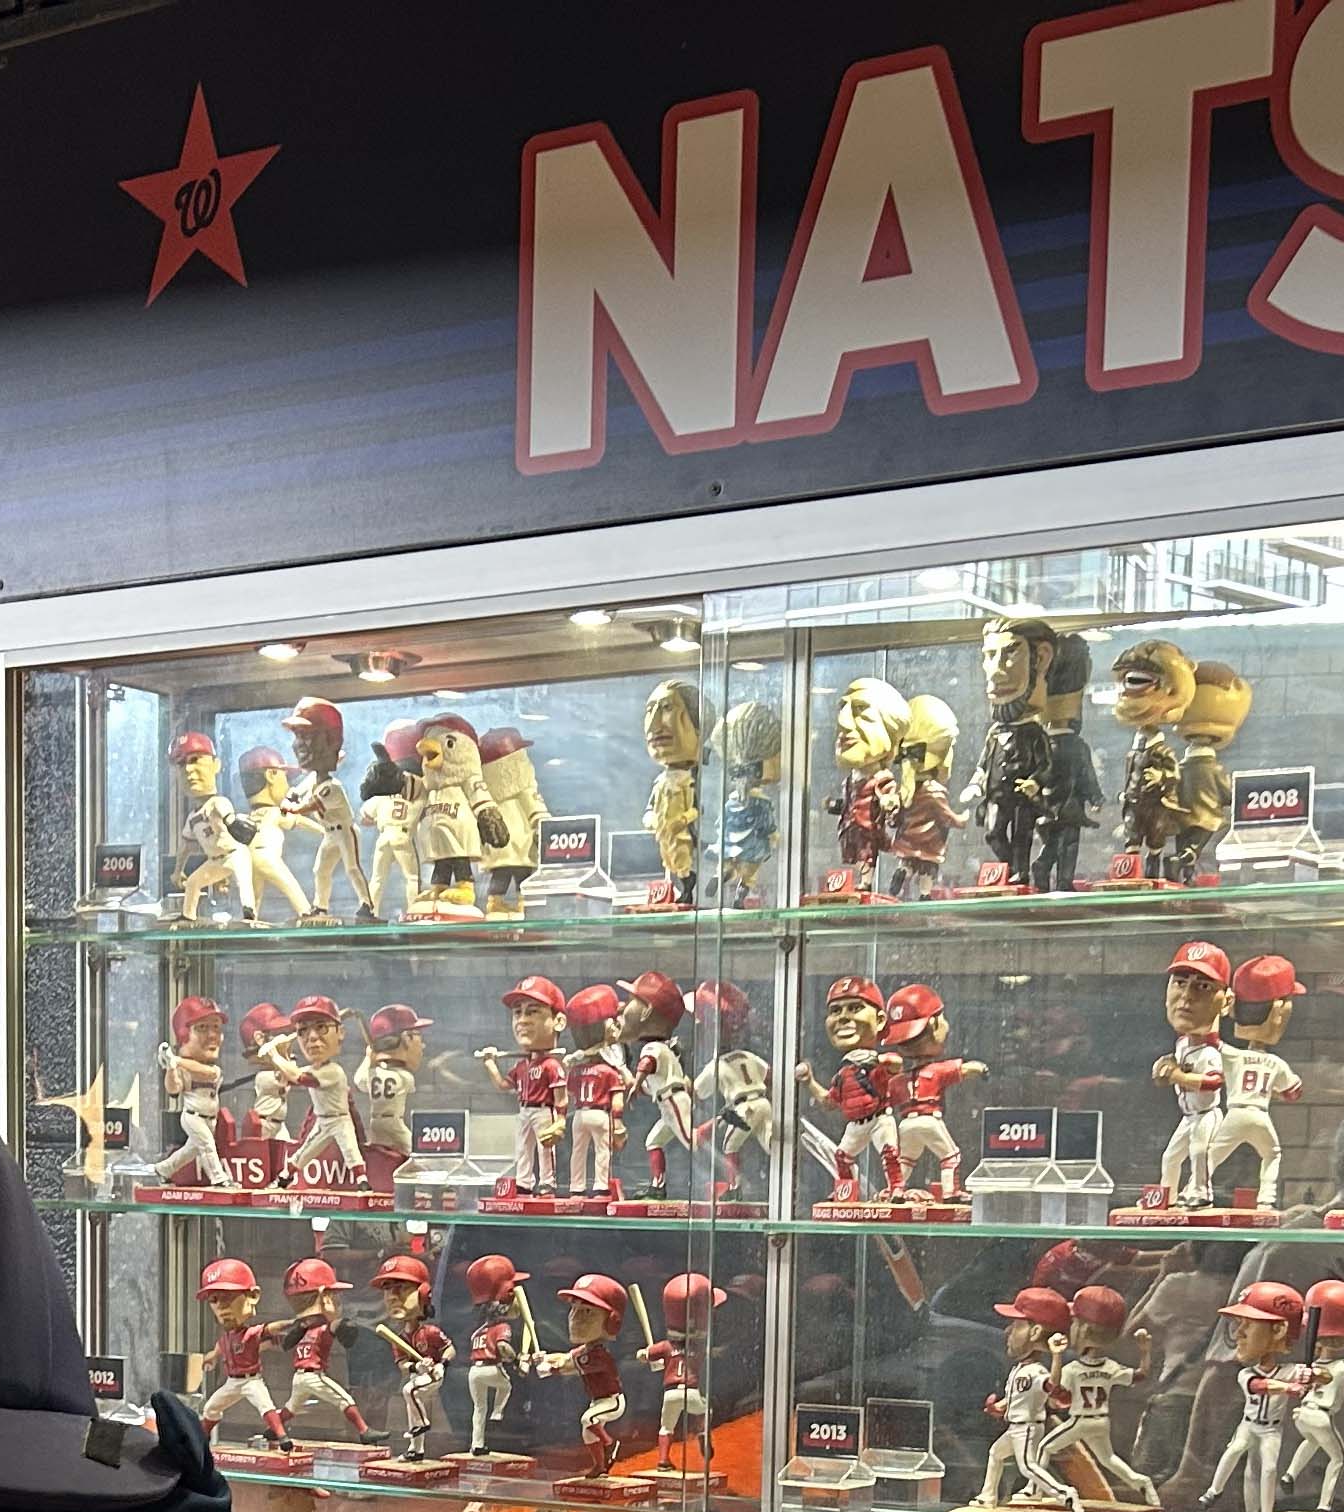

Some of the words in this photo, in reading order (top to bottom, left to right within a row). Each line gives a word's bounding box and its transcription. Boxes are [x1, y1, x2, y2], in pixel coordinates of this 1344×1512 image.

[1247, 789, 1298, 811] 2008
[549, 832, 588, 851] 2007
[103, 854, 134, 872] 2006
[422, 1127, 456, 1143] 2010
[999, 1124, 1038, 1142] 2011
[810, 1423, 847, 1441] 2013
